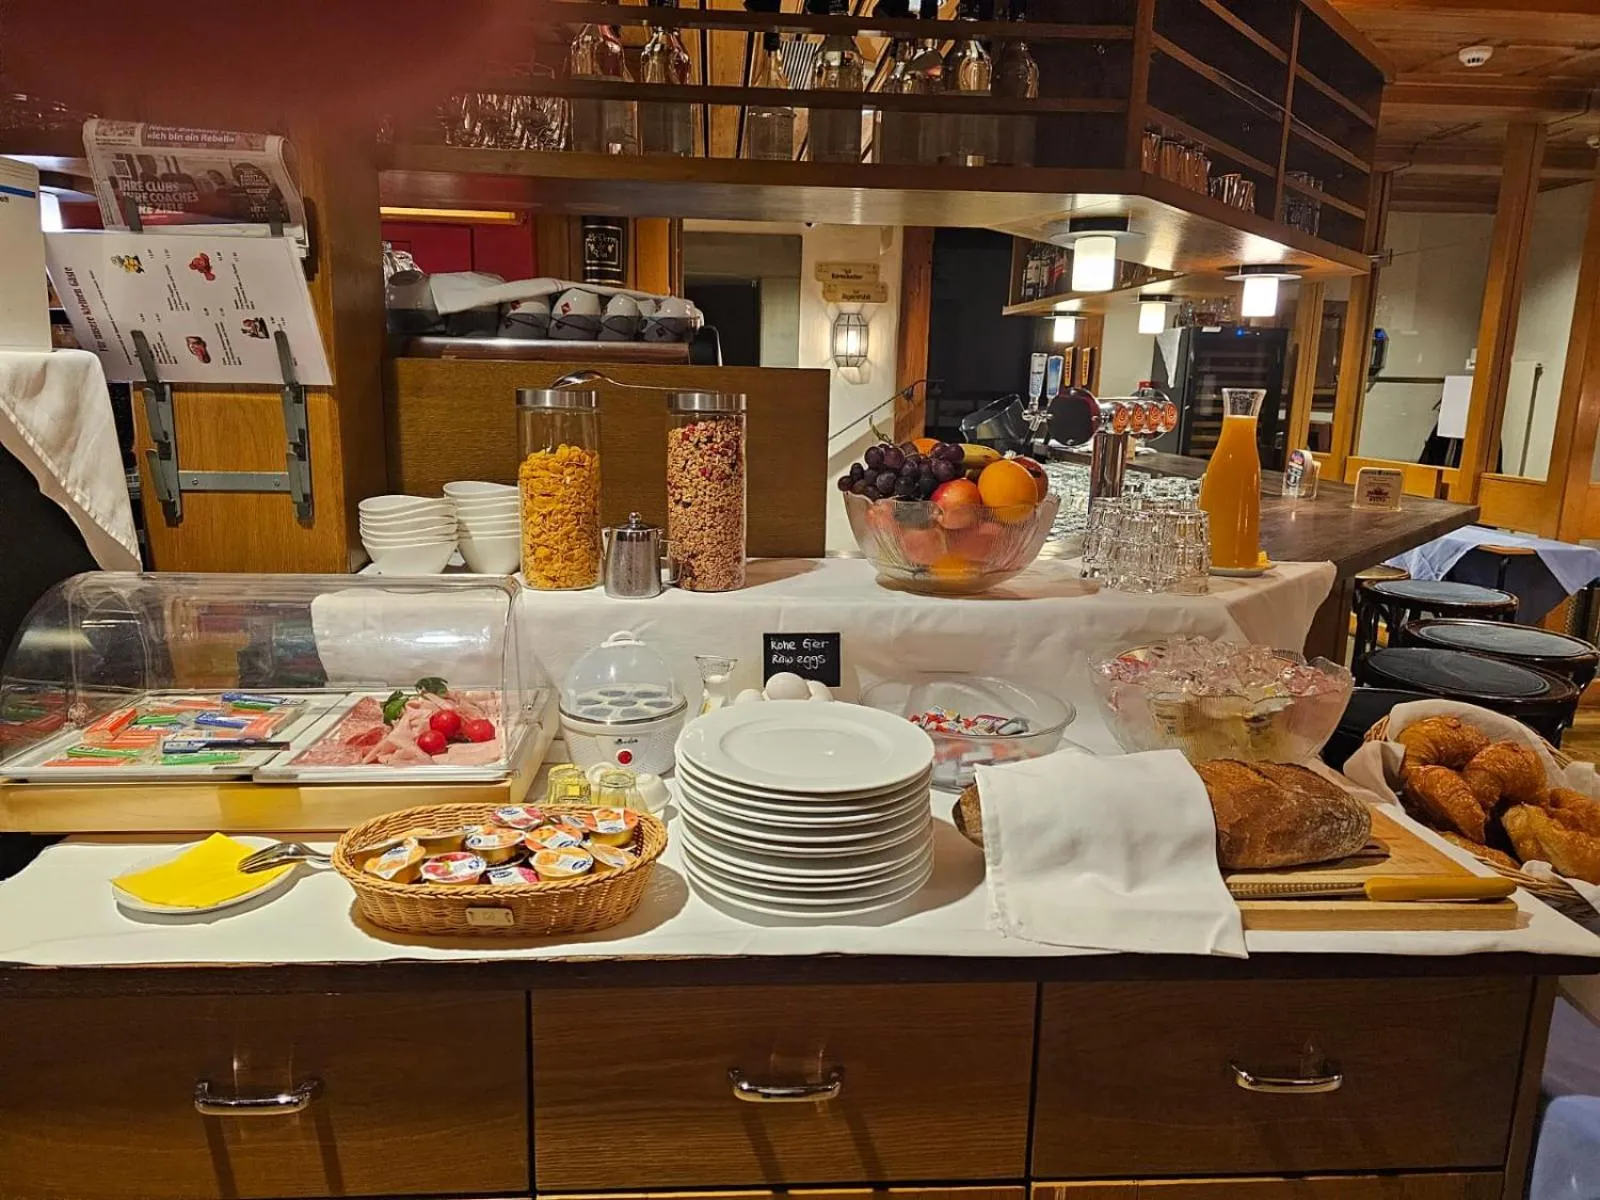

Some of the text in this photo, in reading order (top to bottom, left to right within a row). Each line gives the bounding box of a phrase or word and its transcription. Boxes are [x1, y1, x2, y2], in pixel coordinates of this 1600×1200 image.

[168, 133, 183, 141] bin
[185, 133, 199, 142] ein
[120, 180, 180, 192] IHRE CLUBS
[149, 191, 199, 203] COACHES
[796, 654, 826, 670] eggs
